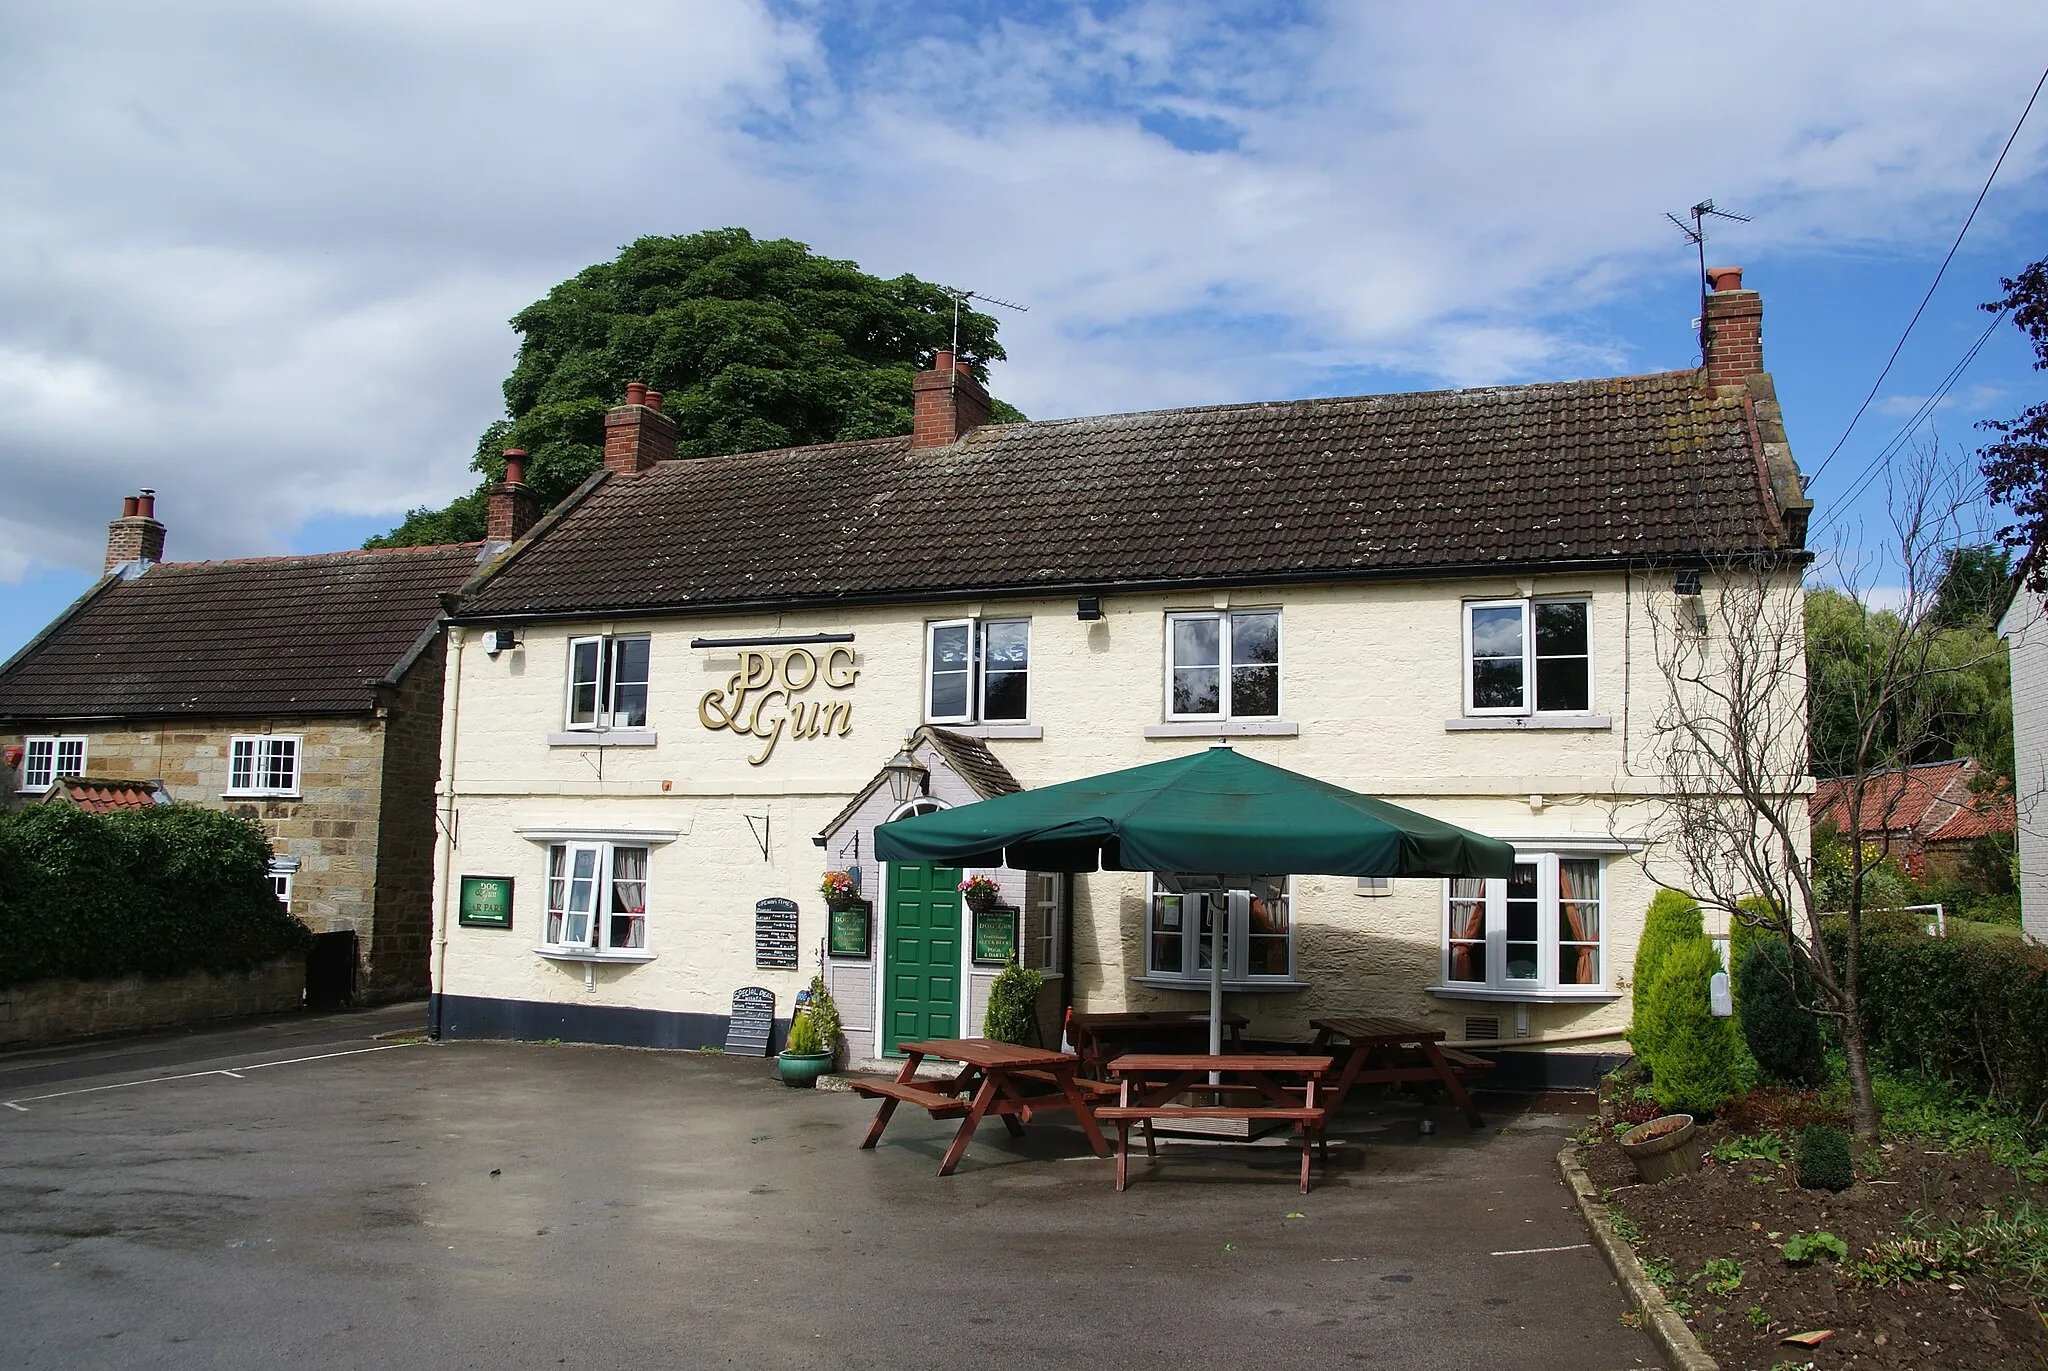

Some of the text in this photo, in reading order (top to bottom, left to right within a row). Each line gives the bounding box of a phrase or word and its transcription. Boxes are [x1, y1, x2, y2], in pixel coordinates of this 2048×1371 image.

[736, 647, 861, 691] DOG
[746, 690, 853, 766] Gun
[484, 904, 504, 912] PARK
